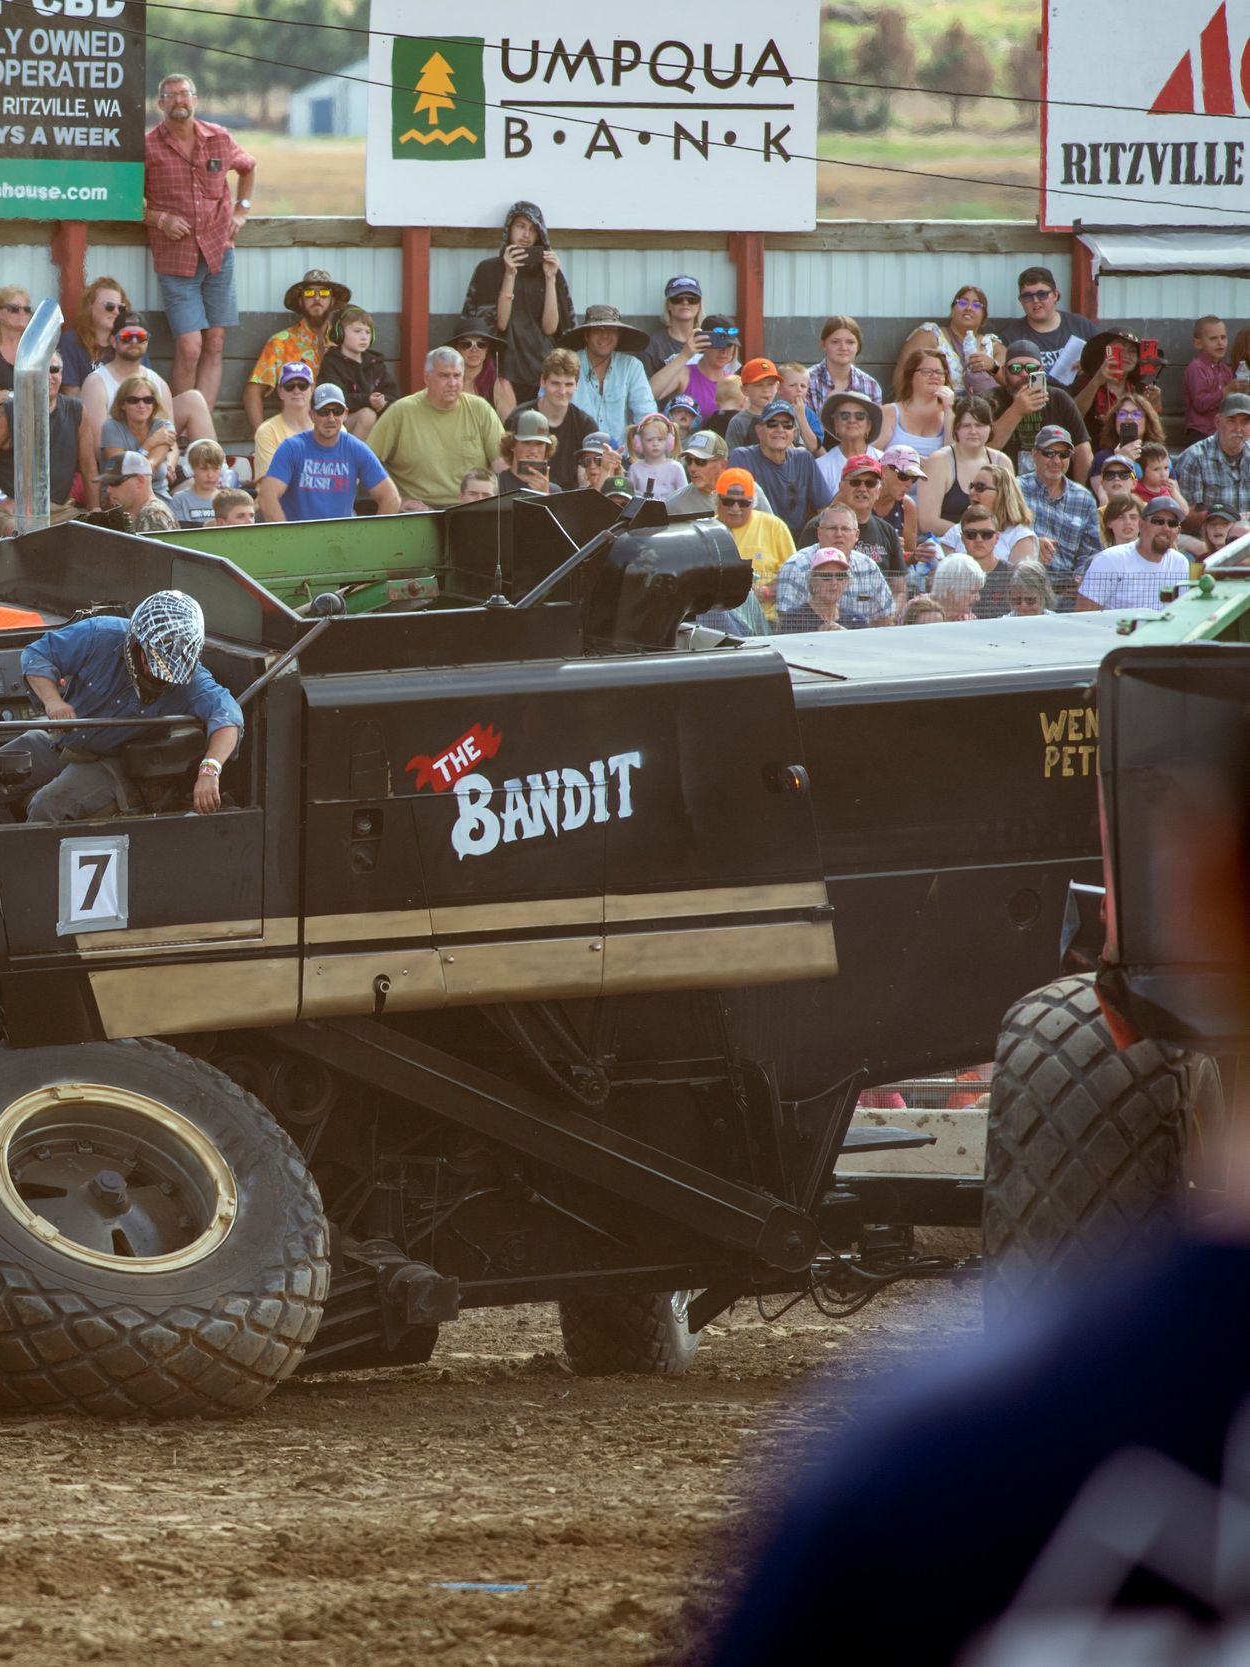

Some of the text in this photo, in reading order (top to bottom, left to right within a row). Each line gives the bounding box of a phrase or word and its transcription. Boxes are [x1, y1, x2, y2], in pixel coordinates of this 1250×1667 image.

[29, 28, 125, 57] OWNED
[501, 37, 793, 94] UMPQUA
[3, 97, 90, 119] RITZVILLE,
[94, 99, 123, 118] WA
[30, 127, 48, 145] A
[52, 127, 122, 147] WEEK
[1060, 141, 1245, 185] RITZVILLE
[299, 472, 331, 490] BUSH
[303, 459, 350, 476] REAGAN
[432, 736, 482, 782] THE
[451, 751, 642, 861] BANDIT
[78, 854, 113, 911] 7
